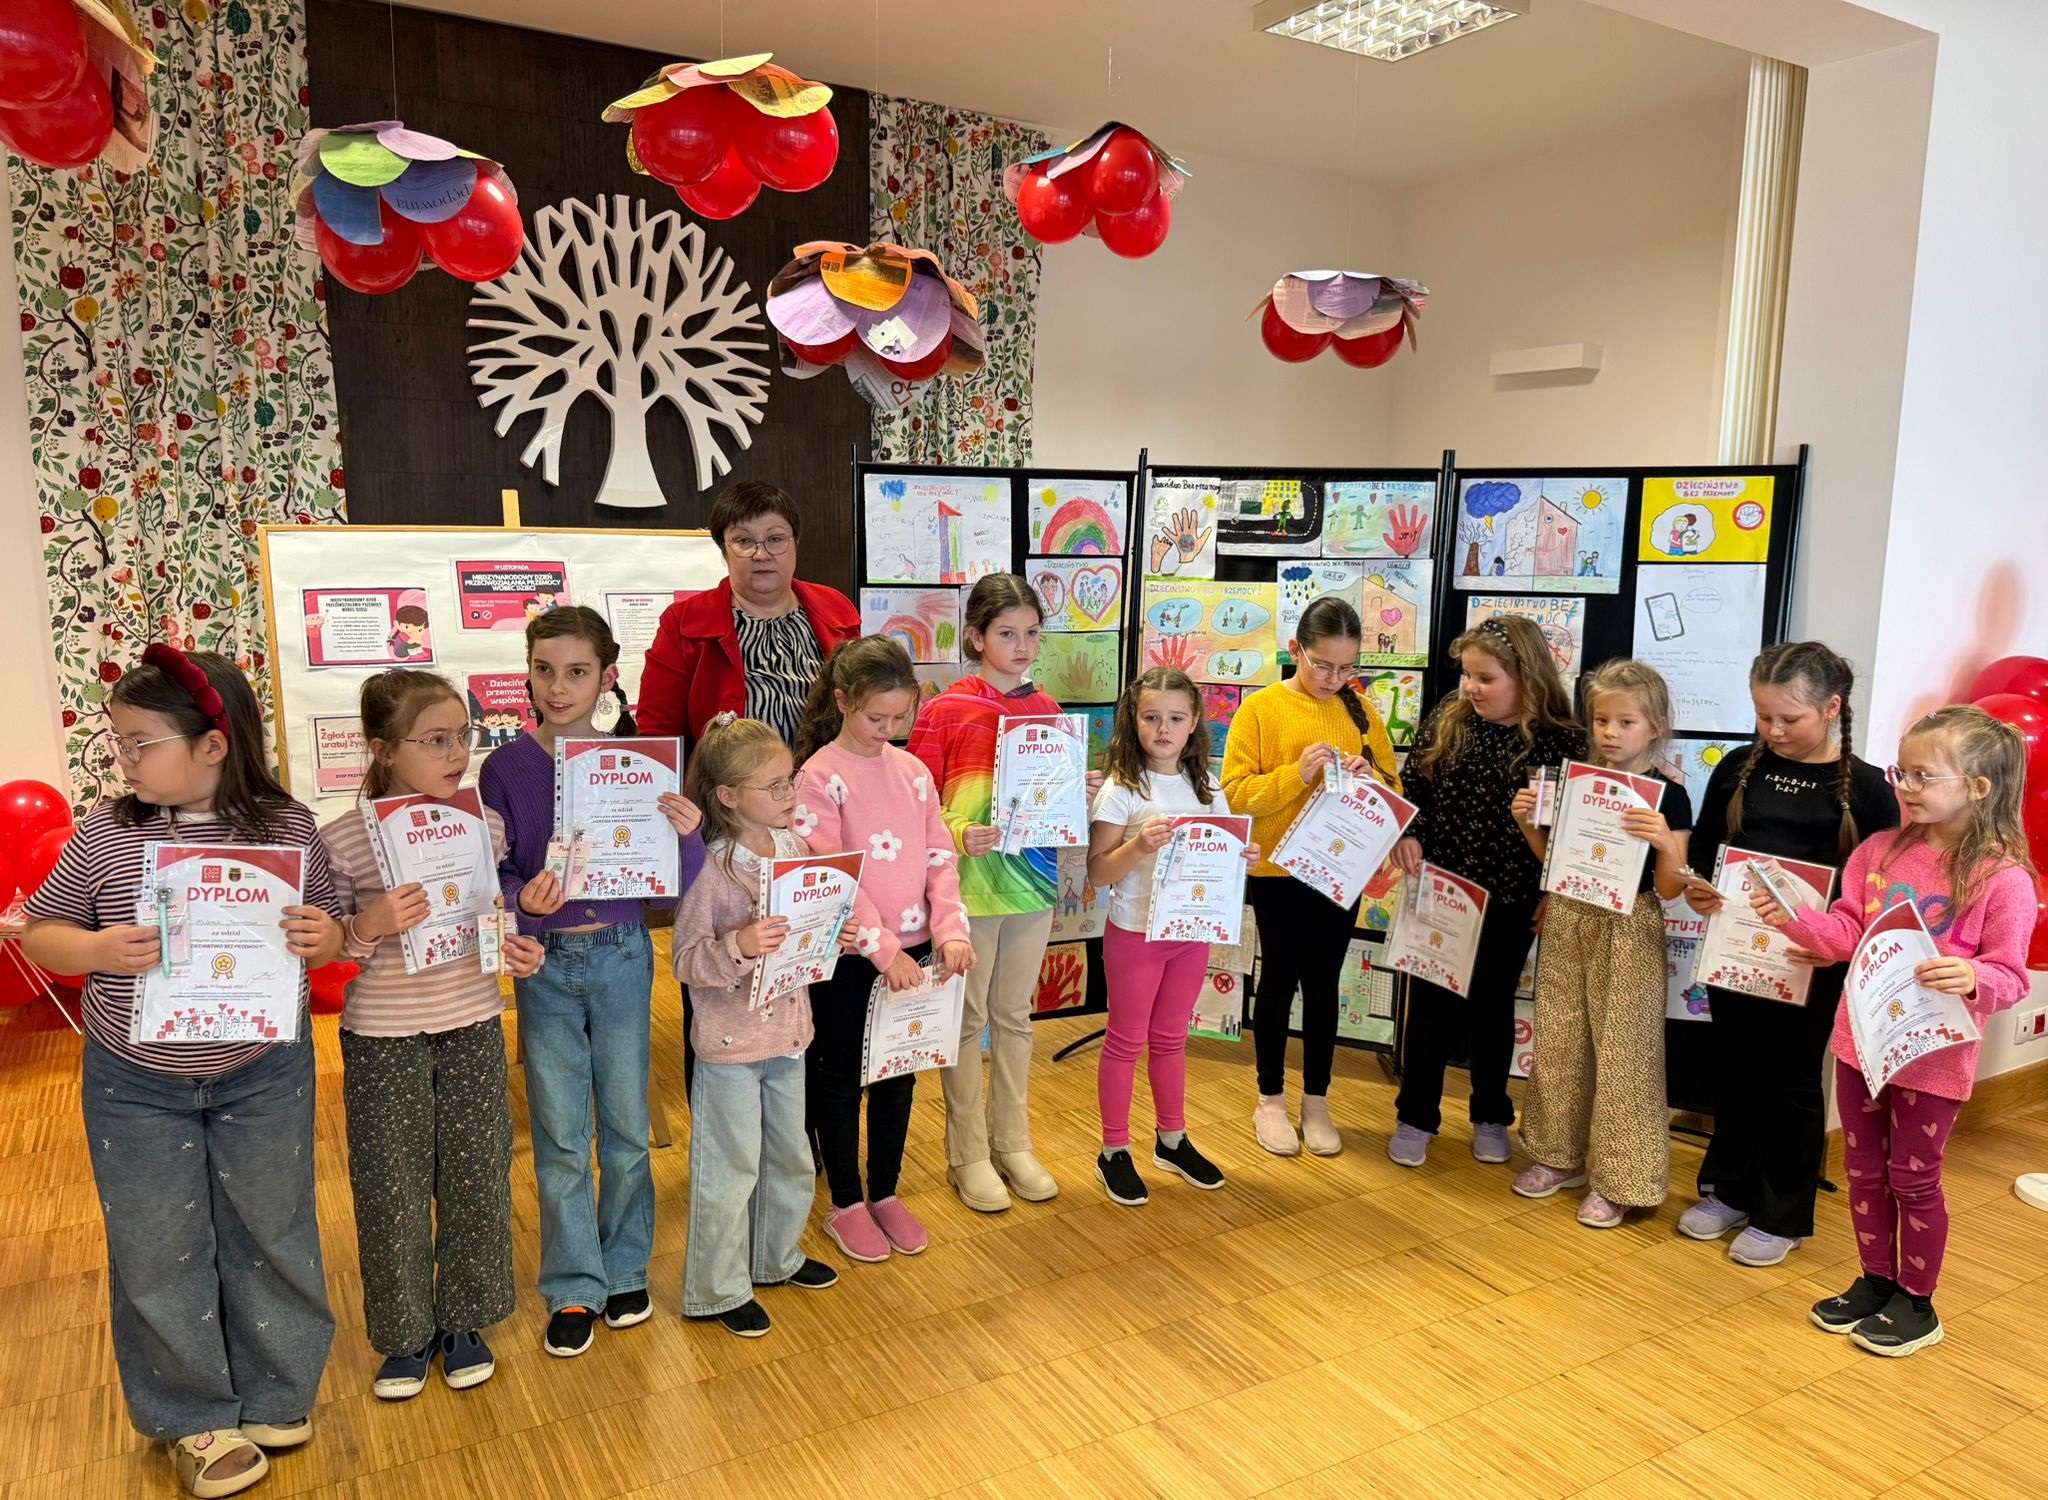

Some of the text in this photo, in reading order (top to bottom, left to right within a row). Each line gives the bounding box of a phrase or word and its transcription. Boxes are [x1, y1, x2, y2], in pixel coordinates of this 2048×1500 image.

[1550, 599, 1579, 613] BEZ
[486, 689, 527, 697] przemocy
[321, 731, 346, 741] Zgłoś
[321, 741, 347, 749] uratuj
[1018, 743, 1066, 755] DYPLOM
[589, 772, 654, 786] DYPLOM
[1340, 794, 1385, 828] DYPLOM
[406, 823, 467, 845] DYPLOM
[1187, 842, 1228, 852] YPLOM
[187, 886, 270, 903] DYPLOM
[793, 884, 841, 903] DYPLOM
[1859, 941, 1904, 991] DYPLOM
